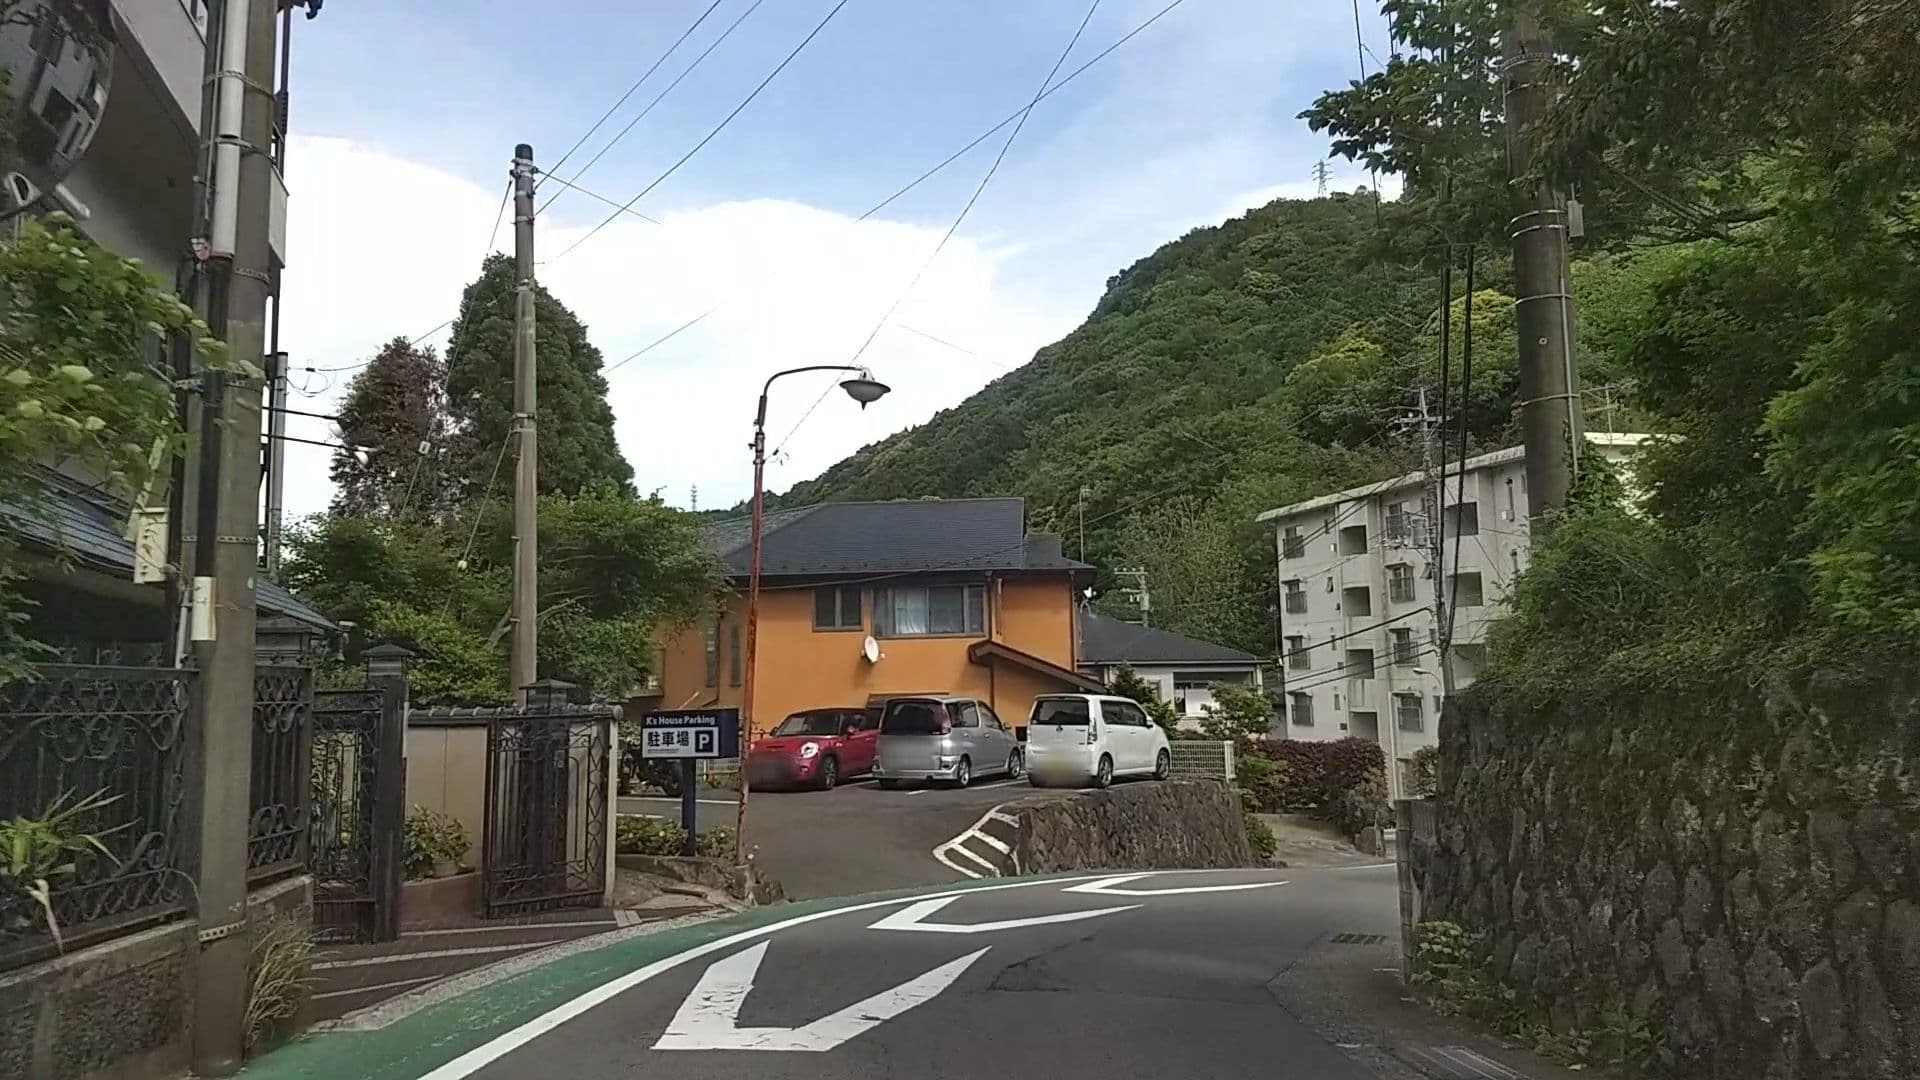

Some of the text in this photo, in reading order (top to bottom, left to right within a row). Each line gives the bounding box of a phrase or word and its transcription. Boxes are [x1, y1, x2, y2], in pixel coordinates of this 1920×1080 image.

[658, 716, 683, 725] House
[684, 715, 715, 725] Parking
[647, 730, 689, 747] 駐車場
[699, 733, 709, 750] P
